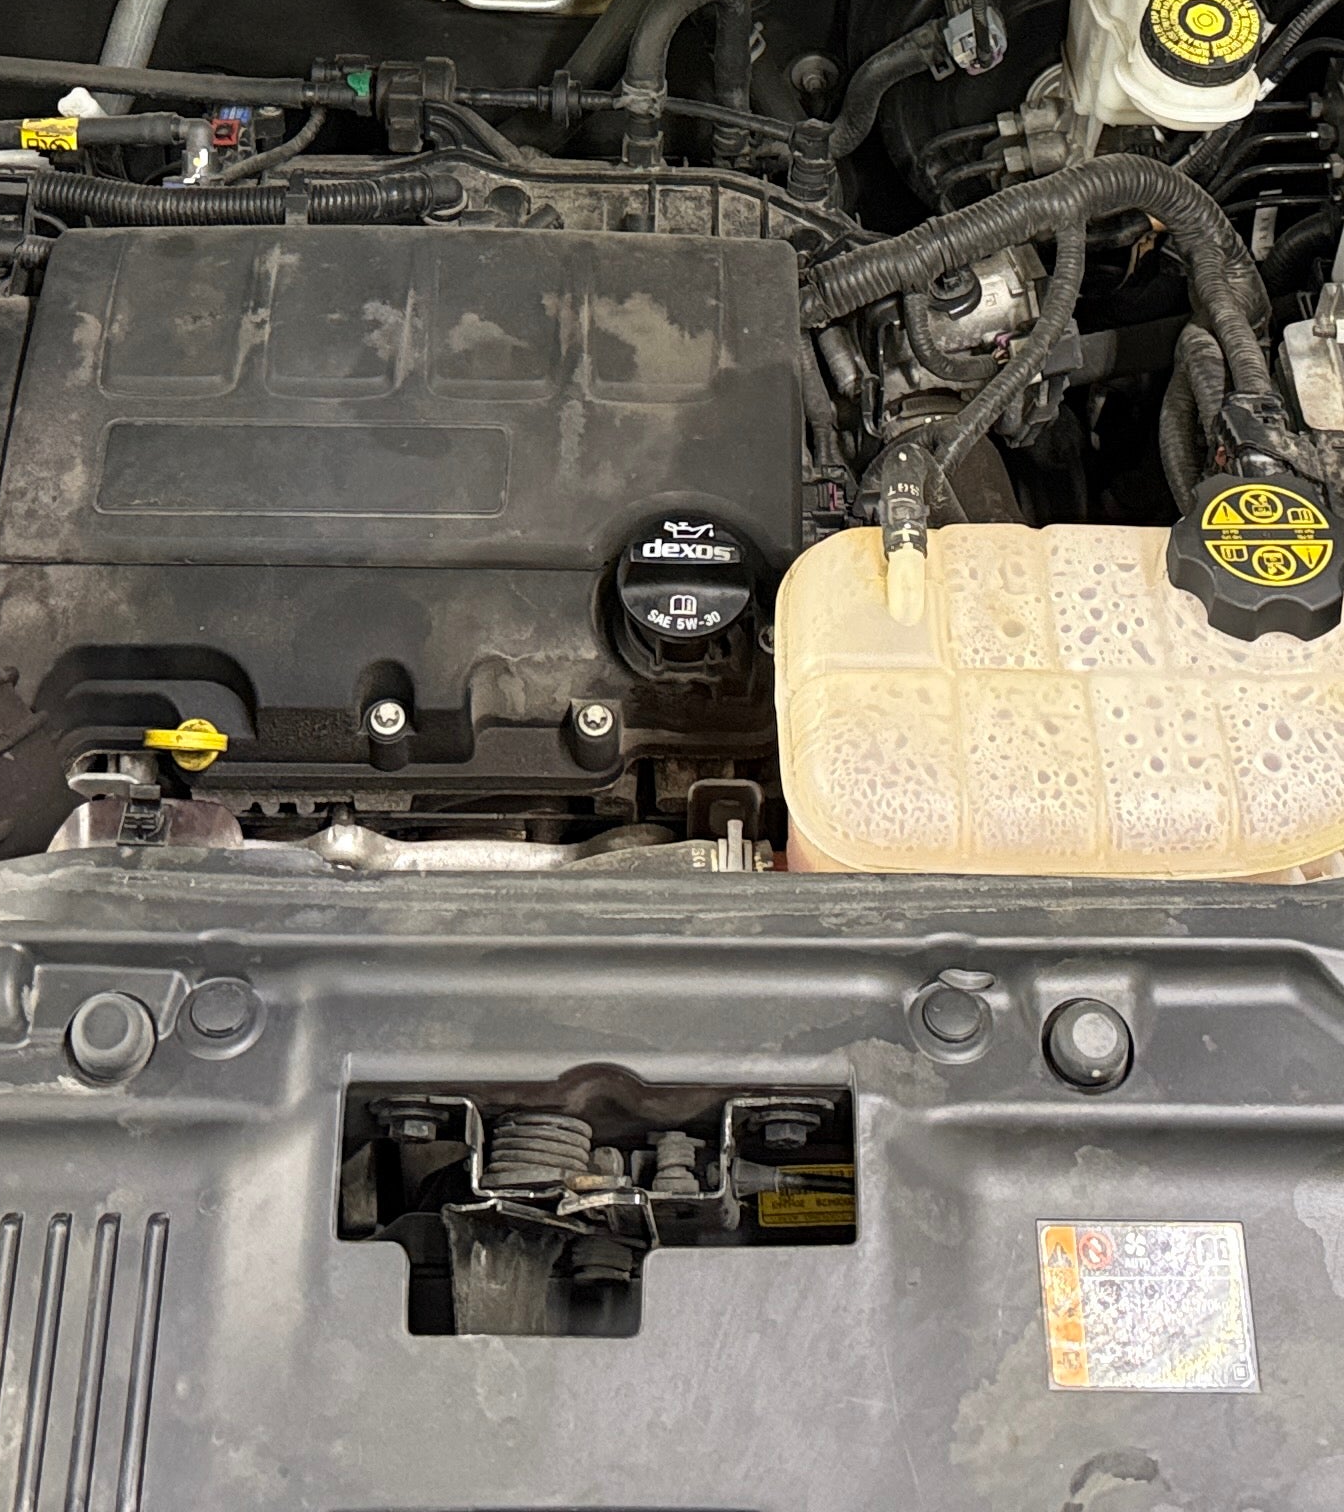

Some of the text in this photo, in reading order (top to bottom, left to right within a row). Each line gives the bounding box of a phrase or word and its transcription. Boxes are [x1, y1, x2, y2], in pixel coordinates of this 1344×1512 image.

[642, 539, 732, 561] dexos
[647, 609, 721, 631] SAE 5W-30
